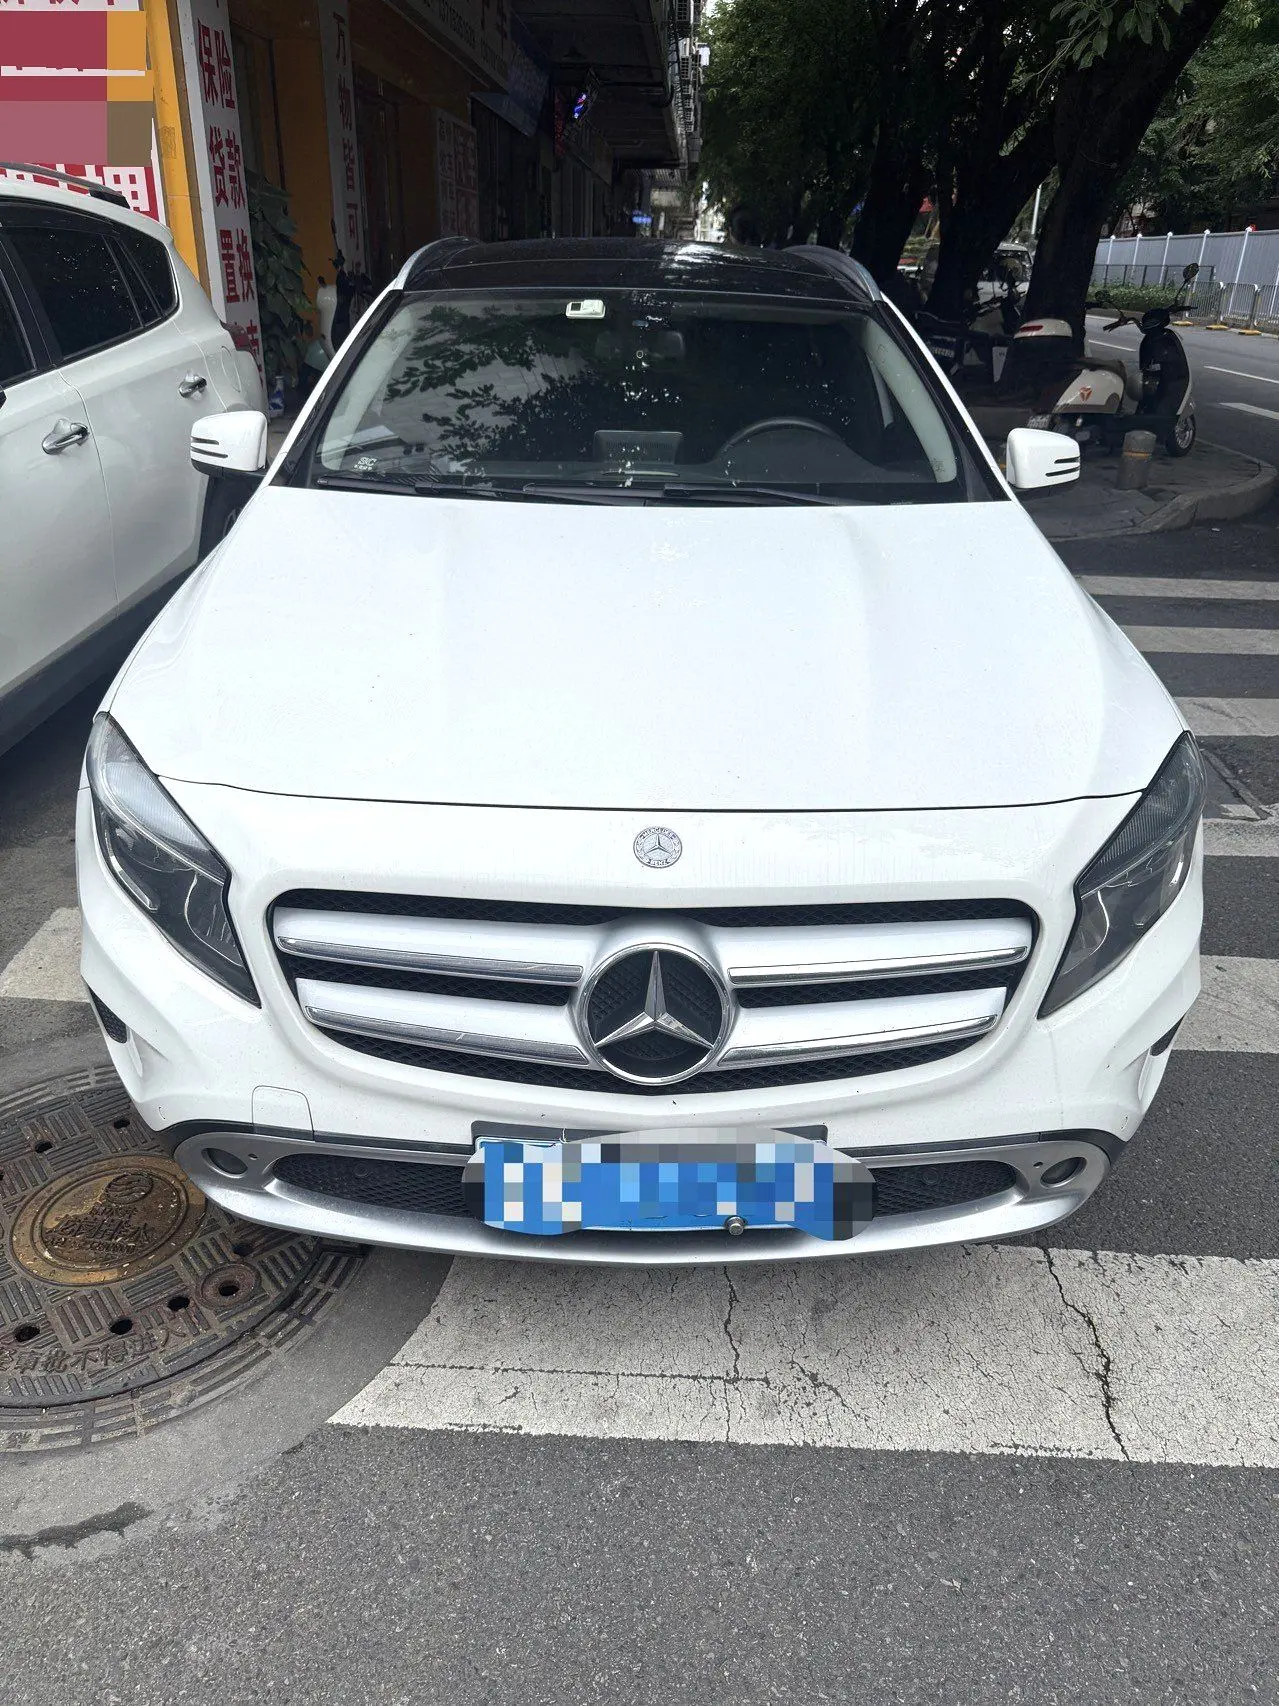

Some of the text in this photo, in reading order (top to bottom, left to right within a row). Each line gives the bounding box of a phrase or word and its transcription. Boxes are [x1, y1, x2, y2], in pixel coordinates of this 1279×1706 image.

[198, 19, 235, 108] 保险
[210, 125, 246, 209] 贷款
[220, 228, 255, 303] 置换
